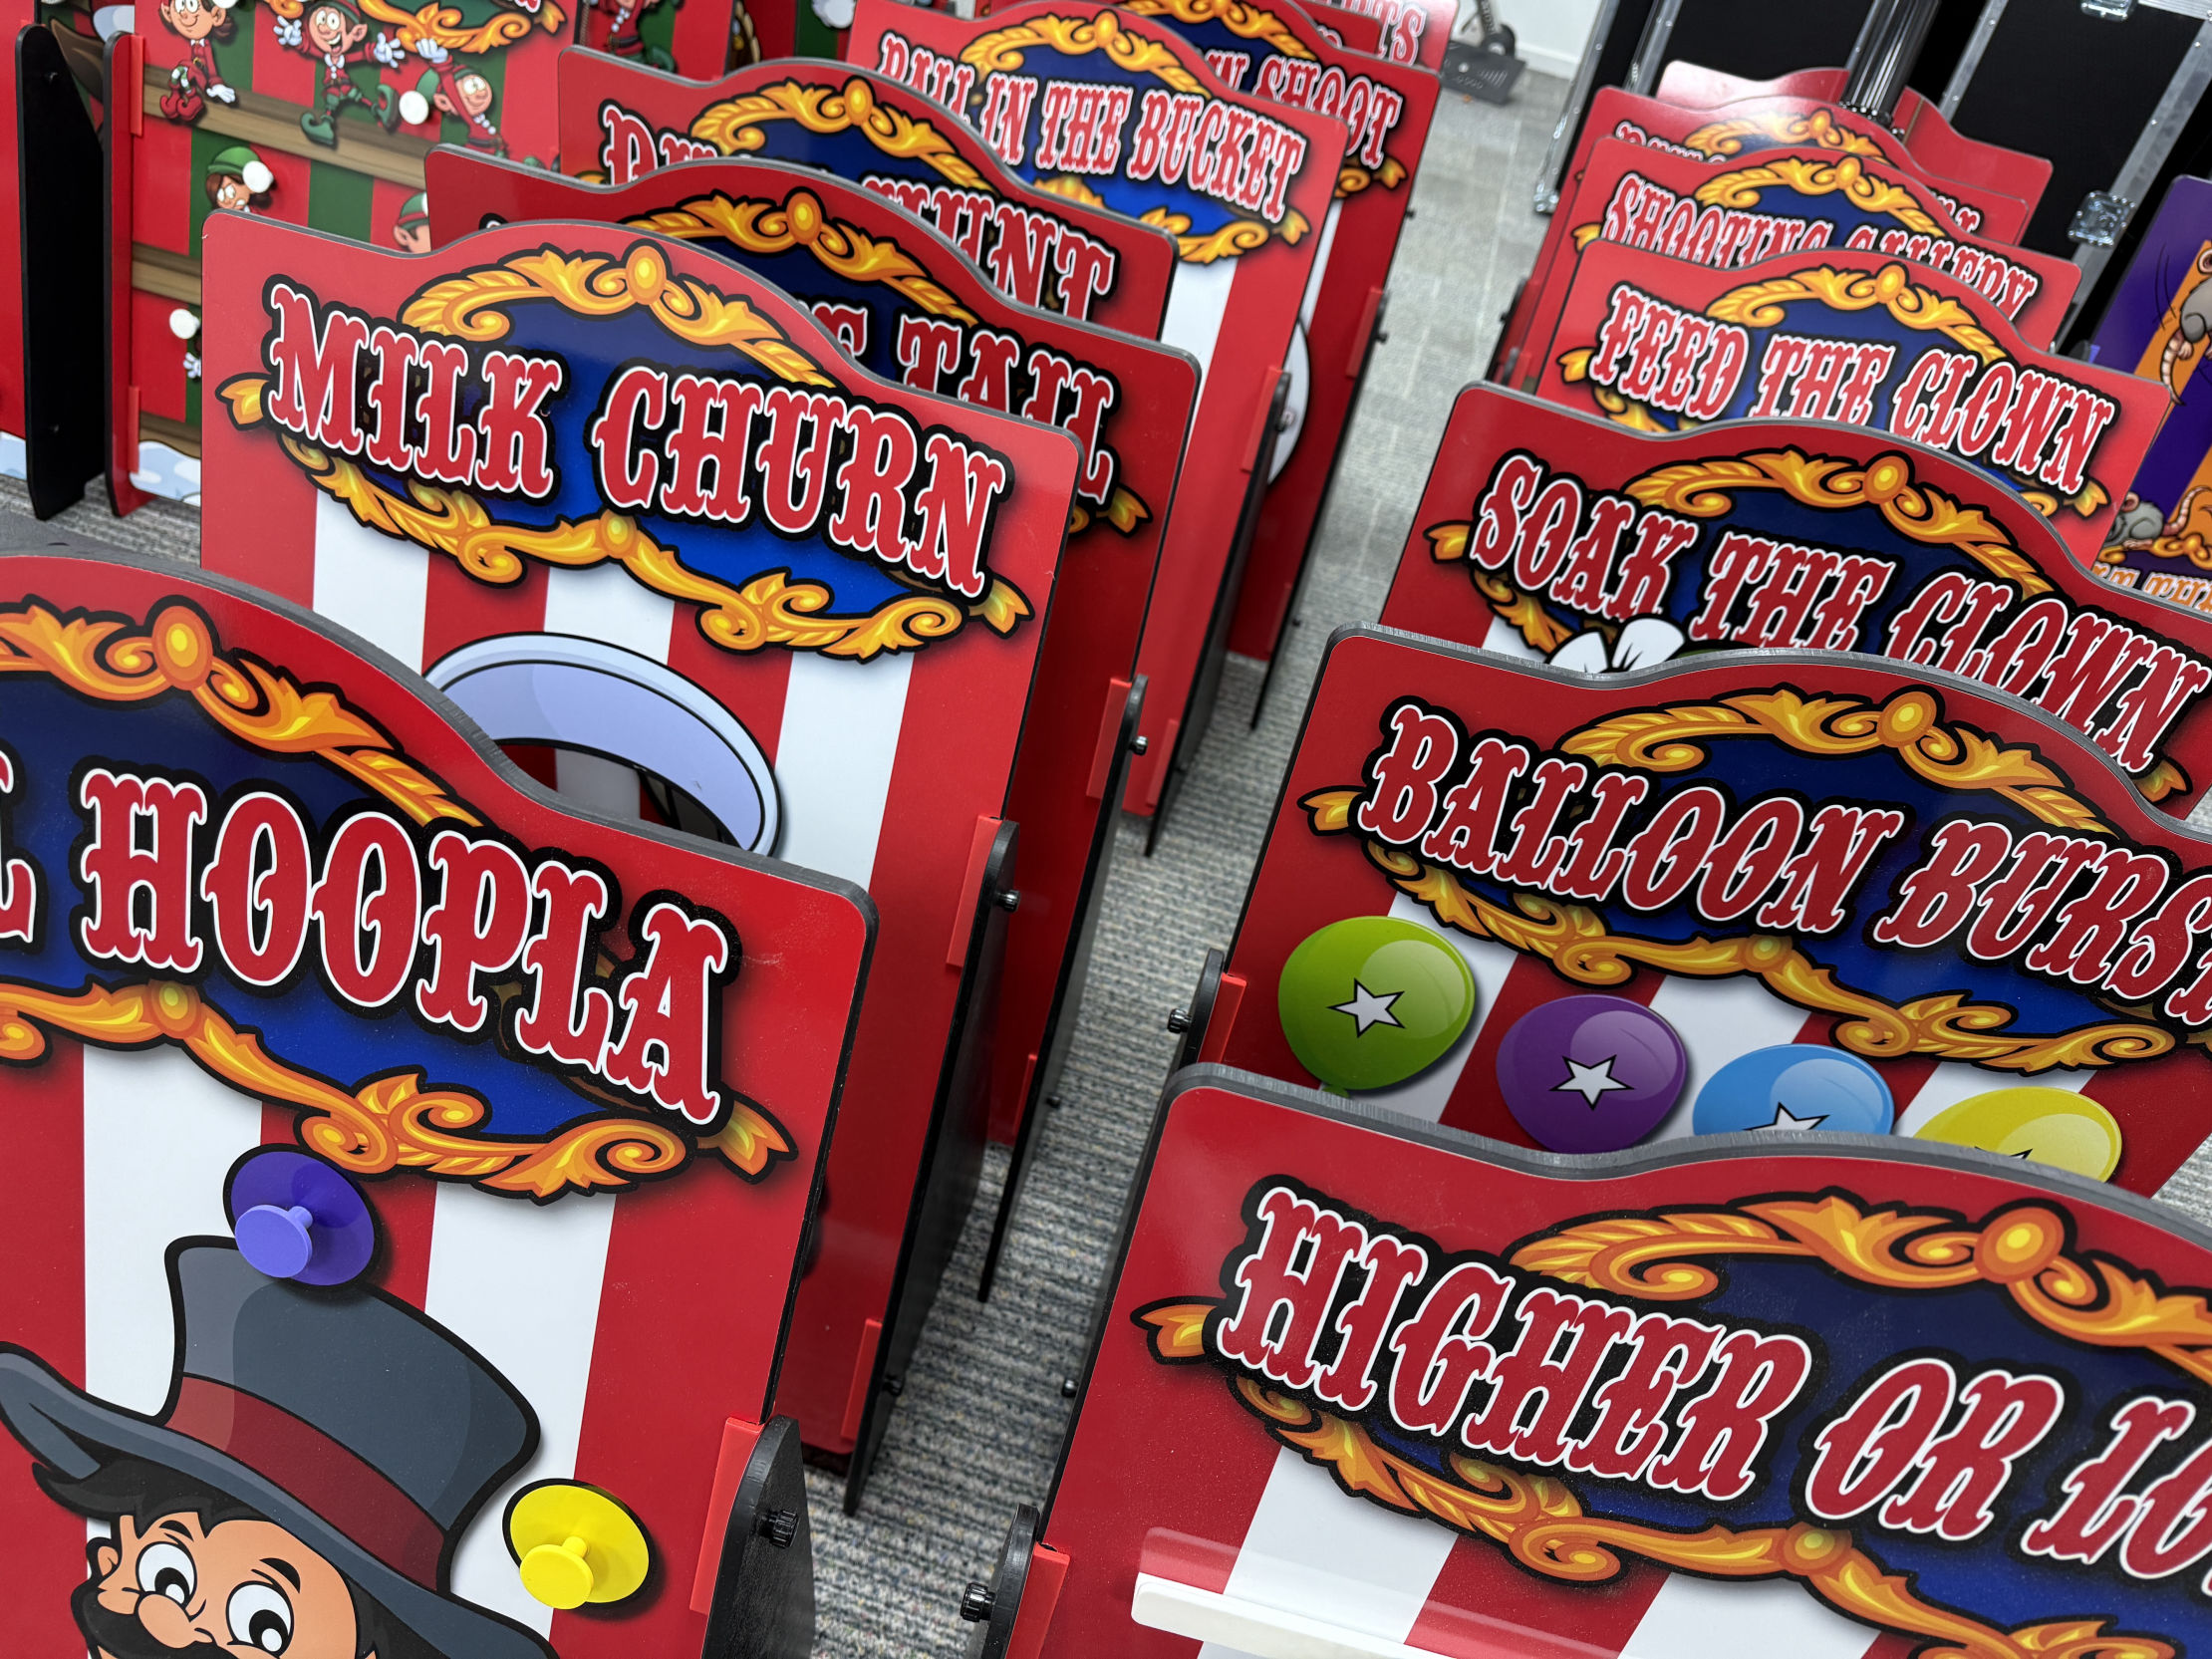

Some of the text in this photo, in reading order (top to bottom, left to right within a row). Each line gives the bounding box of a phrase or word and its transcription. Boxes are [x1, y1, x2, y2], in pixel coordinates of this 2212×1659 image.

[980, 73, 1038, 165] IN
[1035, 81, 1134, 175] THE
[1126, 90, 1307, 223] BUCKET
[1600, 172, 1834, 271] SHOOTI
[269, 284, 1005, 597] MILK CHURN
[1589, 285, 2113, 494] FEED THE CLOWN
[1470, 455, 2211, 773] SOAK THE CLOWN
[81, 768, 729, 1125] HOOPLA
[1358, 704, 1903, 934] BALLOON
[1216, 1186, 1811, 1501] HIGHER
[1804, 1358, 2066, 1542] OR
